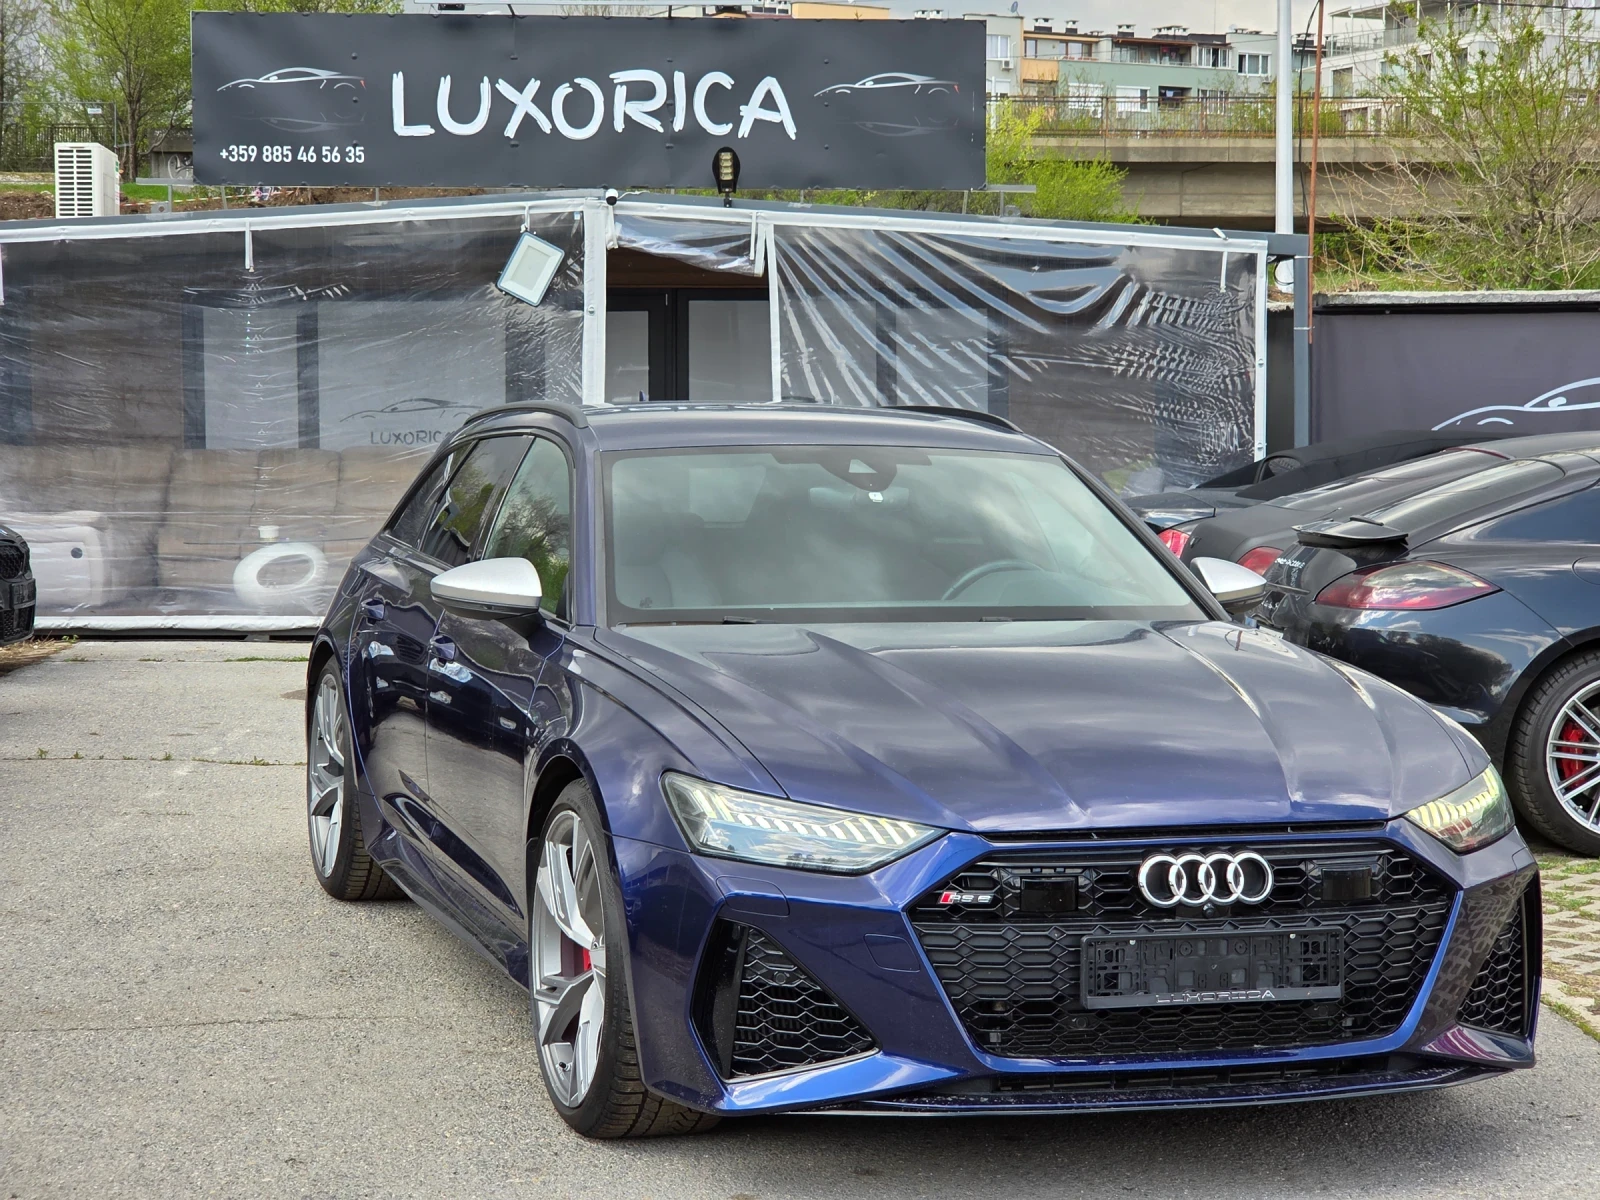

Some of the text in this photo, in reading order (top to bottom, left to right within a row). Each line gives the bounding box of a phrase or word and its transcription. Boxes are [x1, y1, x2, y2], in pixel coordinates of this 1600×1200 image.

[391, 69, 797, 140] LUXORICA
[219, 145, 365, 163] +359 885 46 56 35
